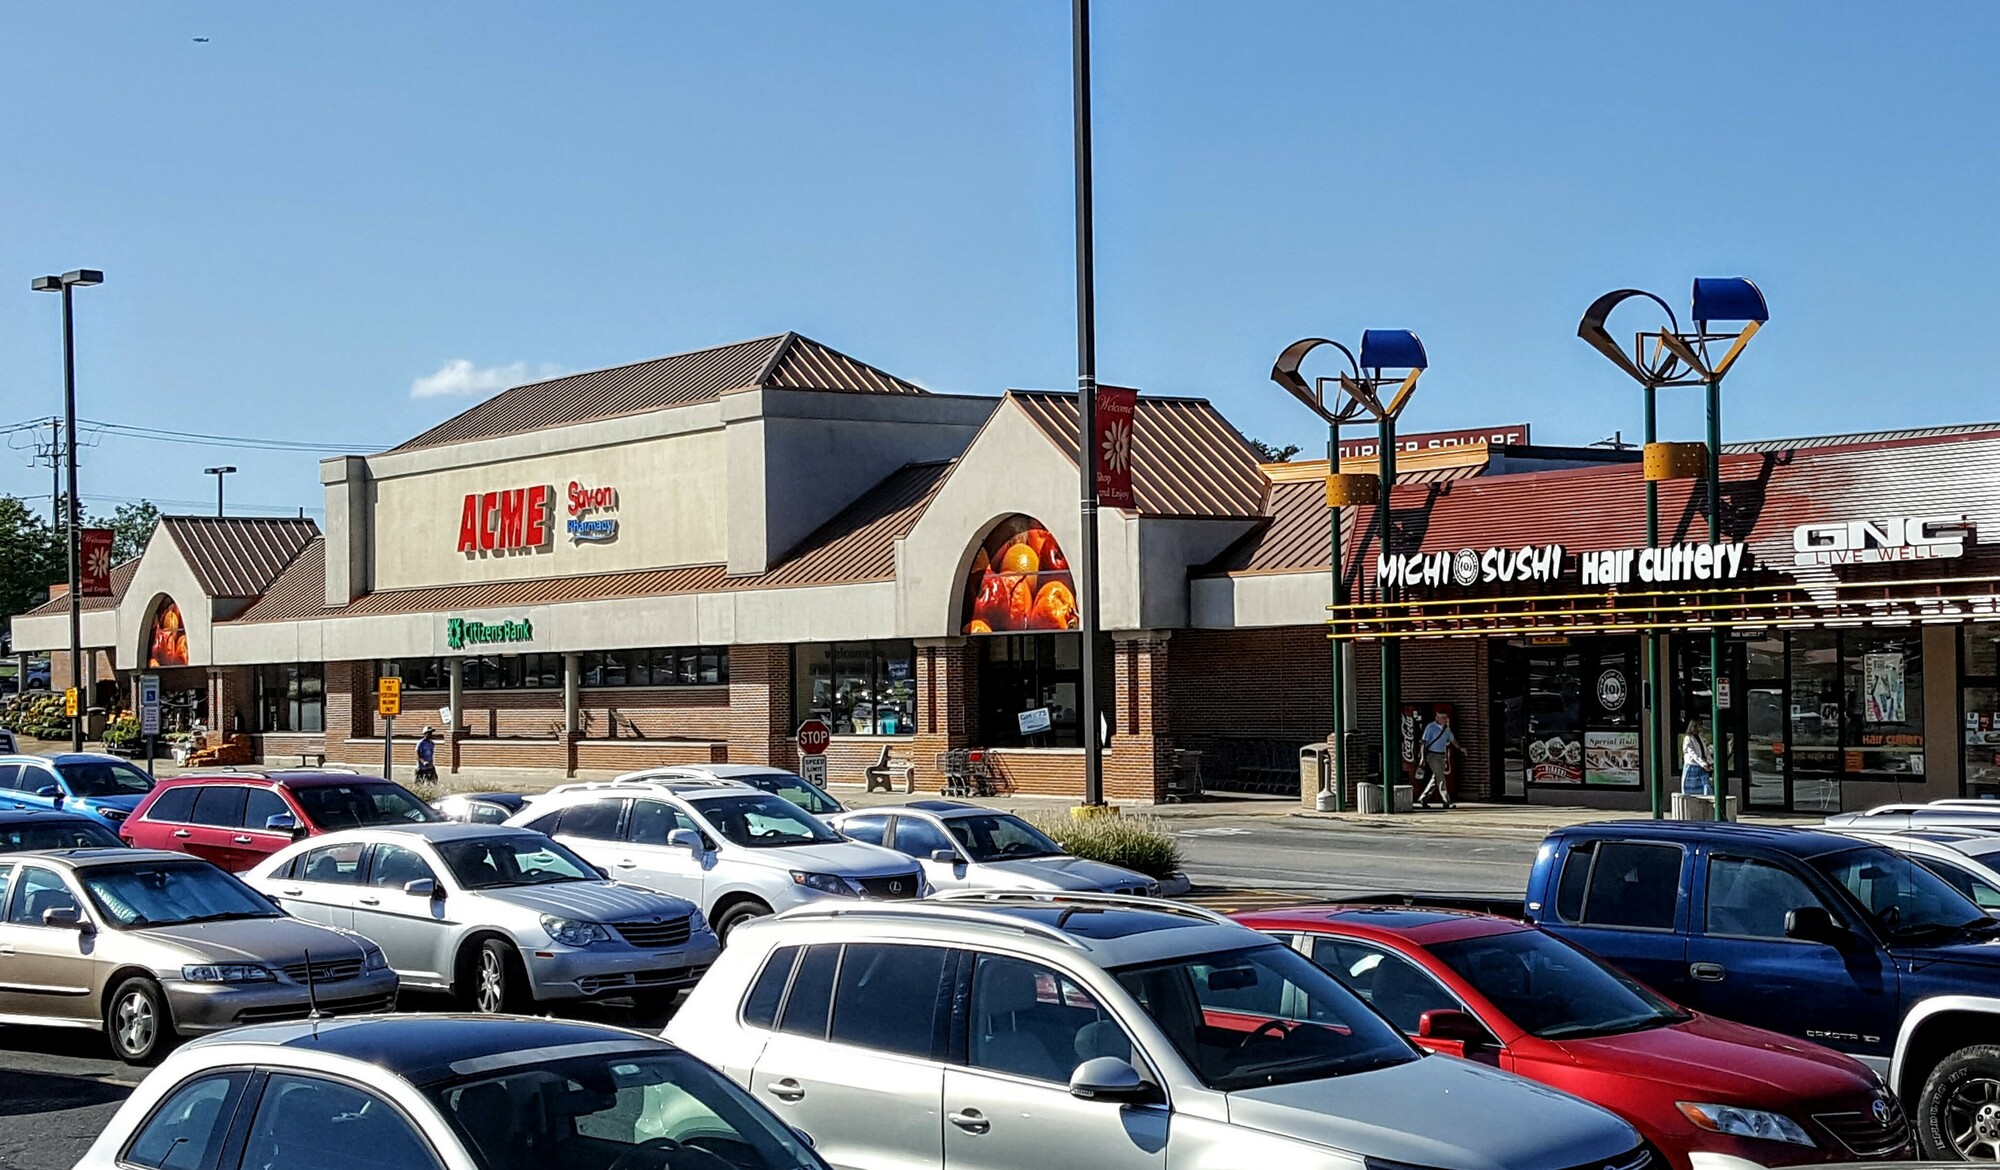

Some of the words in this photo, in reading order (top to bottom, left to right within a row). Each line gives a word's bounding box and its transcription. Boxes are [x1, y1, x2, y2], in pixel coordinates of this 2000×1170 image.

[1098, 395, 1133, 414] Welcome
[1338, 440, 1418, 458] TURR
[567, 481, 612, 516] Sav-on
[457, 485, 545, 552] ACME
[567, 519, 615, 534] Pharmacy
[1794, 515, 1964, 553] GNC
[1377, 550, 1450, 588] MICHI
[1482, 544, 1562, 583] SUSHI
[1582, 549, 1634, 585] Hair
[1815, 549, 1864, 566] LIVE
[464, 622, 503, 641] Citizens
[504, 620, 530, 640] Bank
[800, 730, 828, 745] STOP
[808, 773, 824, 787] 15
